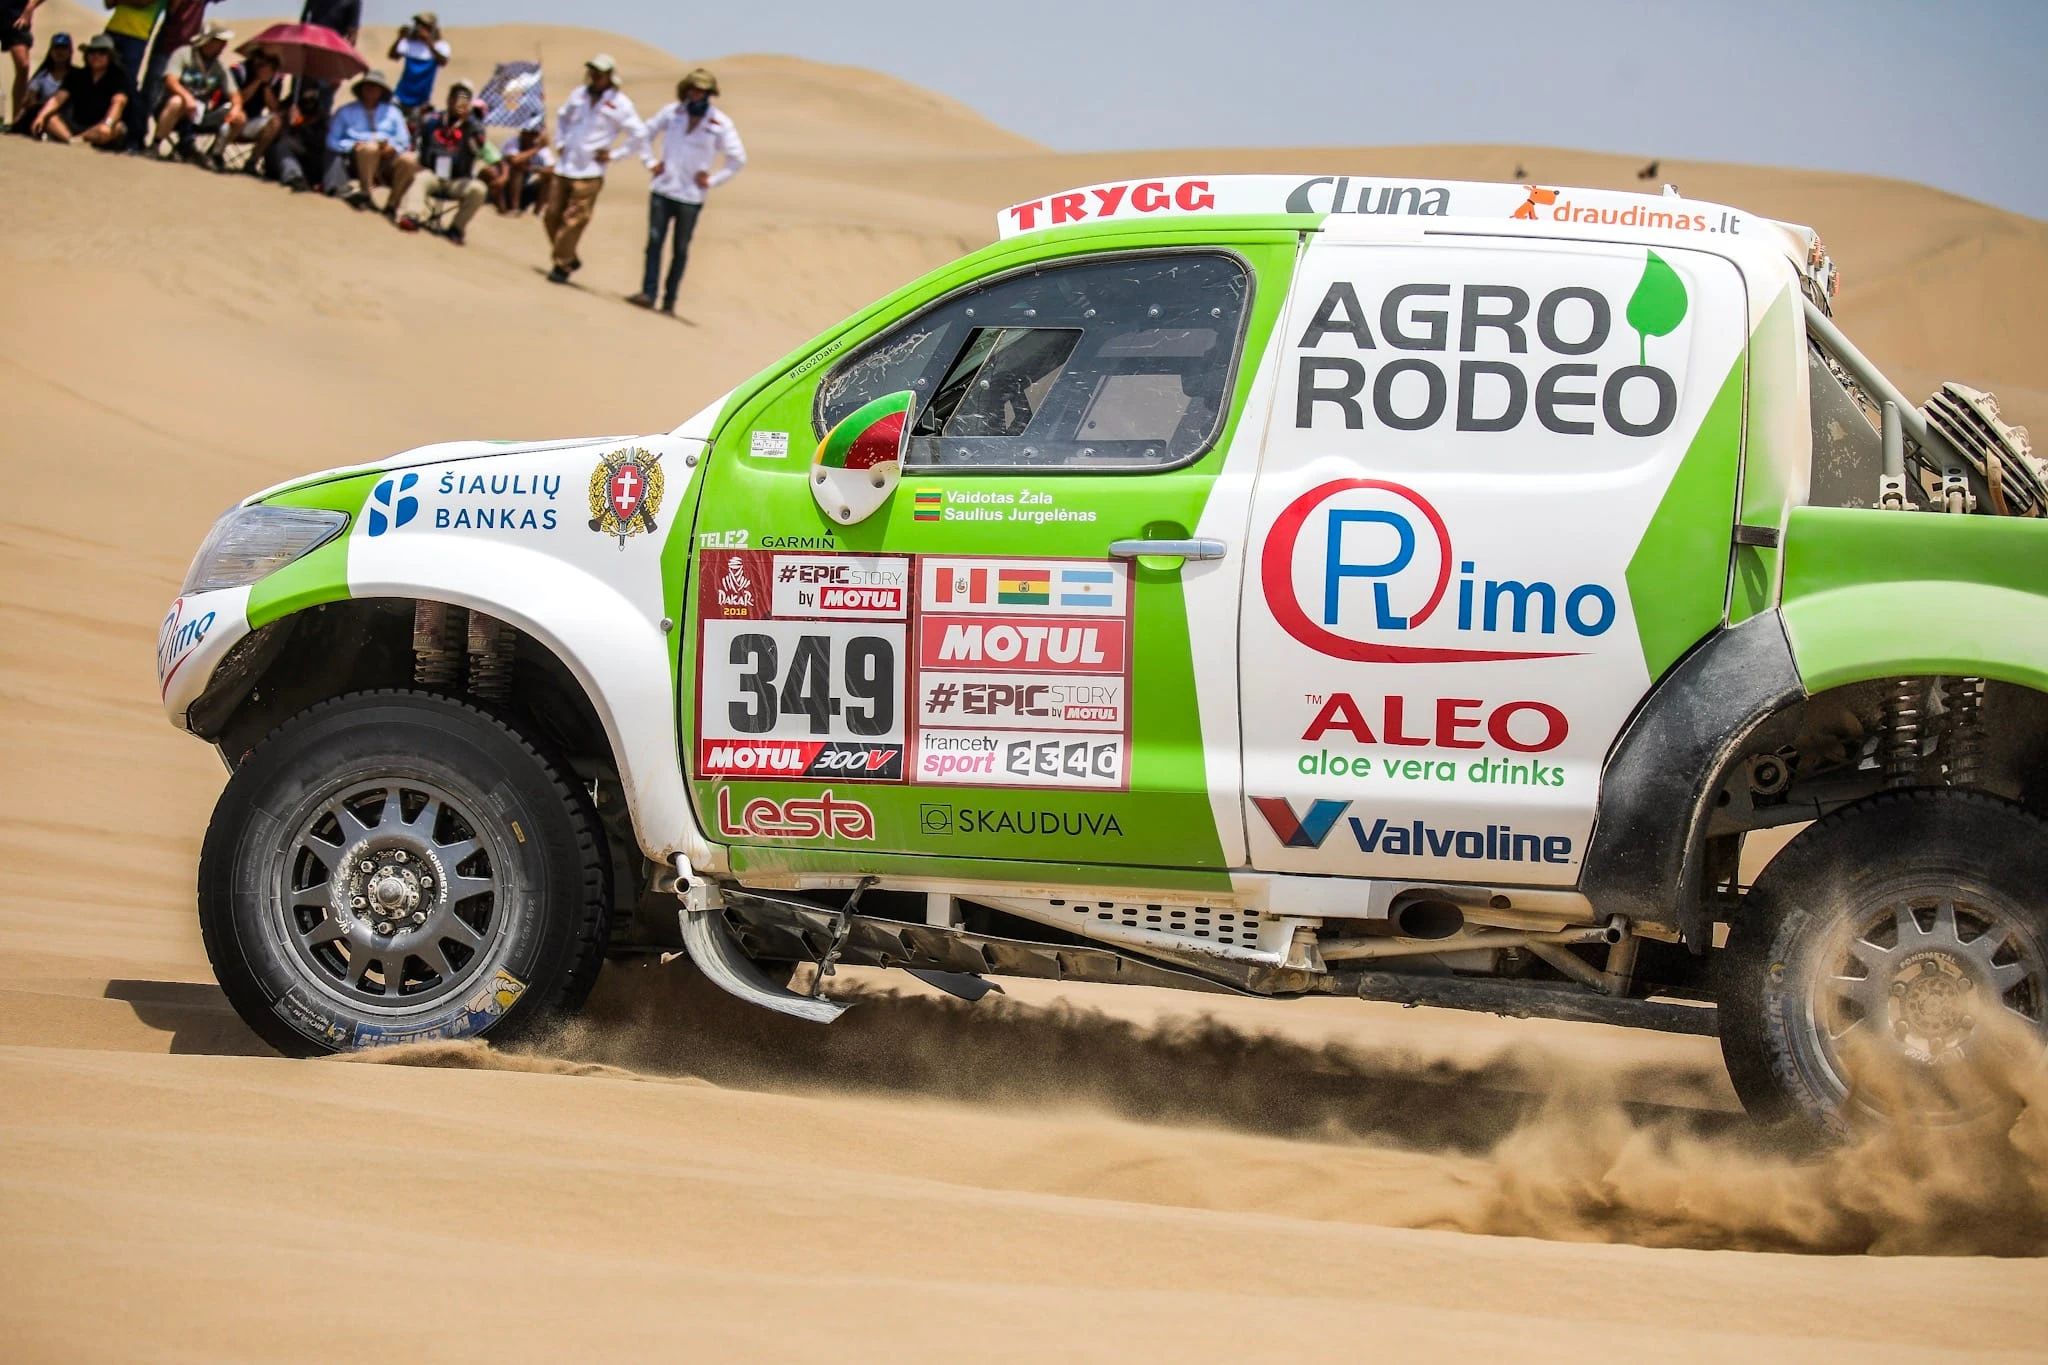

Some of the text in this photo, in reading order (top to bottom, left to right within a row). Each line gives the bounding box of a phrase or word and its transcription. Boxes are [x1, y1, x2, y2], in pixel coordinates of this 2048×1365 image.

[1010, 181, 1215, 230] TRYGG
[1554, 200, 1741, 235] draudimas.lt
[1298, 281, 1613, 355] AGRO
[790, 340, 843, 380] #iGo2Dakar
[1295, 357, 1678, 438] RODEO
[438, 472, 562, 500] ŠIAULIŲ
[946, 489, 1053, 505] Vaidotas Žala
[435, 508, 557, 530] BANKAS
[944, 507, 1097, 525] Saulius Jurgelėnas
[700, 529, 749, 549] TELE2
[761, 536, 835, 549] GARMIN
[851, 570, 903, 585] STORY
[1324, 509, 1616, 636] Rimo
[718, 589, 754, 607] DAKAR
[723, 607, 748, 616] 2018
[799, 590, 897, 608] by MOTUL
[939, 624, 1105, 664] MOTUL
[727, 633, 895, 736] 349
[1051, 685, 1118, 704] STORY
[1051, 707, 1116, 721] by MOTUL
[1301, 693, 1569, 753] ALEO
[924, 734, 999, 751] francetv
[707, 747, 897, 771] MOTUL 300V
[924, 752, 995, 776] sport
[1298, 750, 1565, 787] aloe vera drinks
[718, 785, 876, 840] Lesta
[959, 809, 1124, 837] SKAUDUVA
[1348, 817, 1572, 864] Valvoline
[426, 849, 448, 905] FONDMETAL
